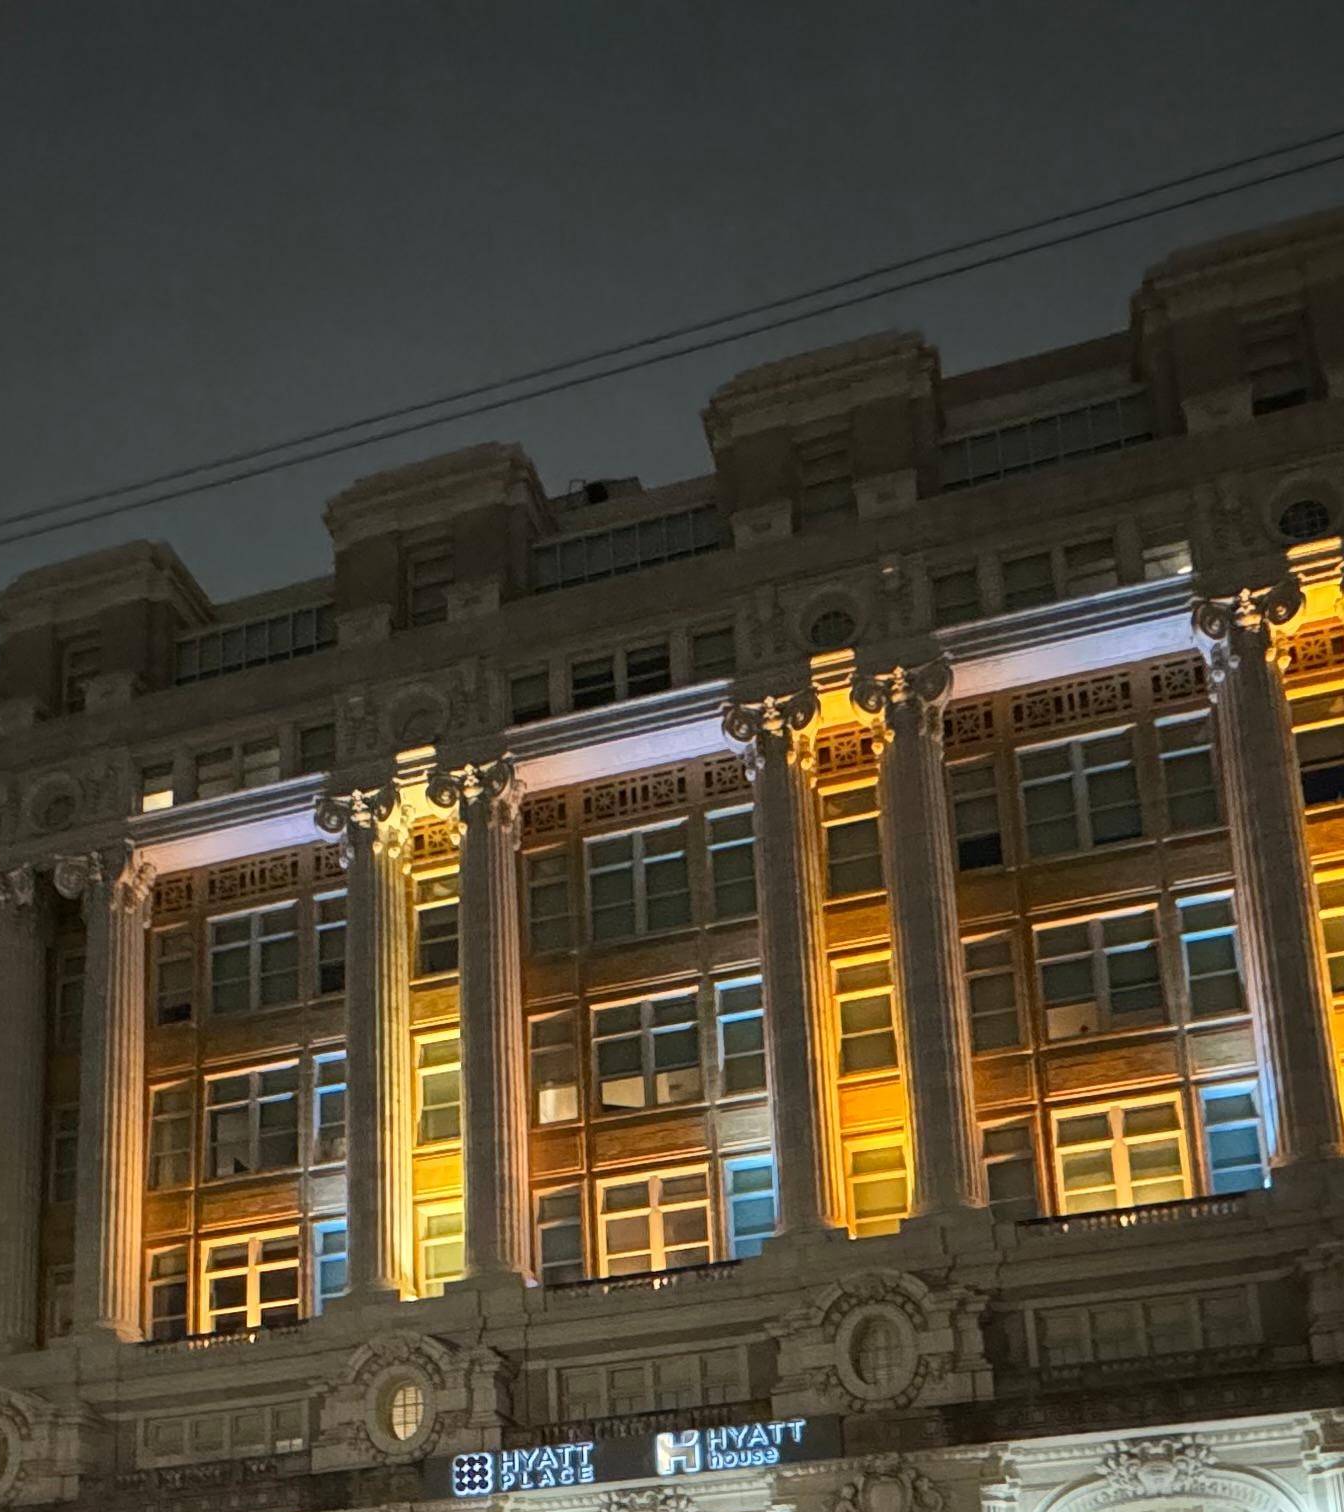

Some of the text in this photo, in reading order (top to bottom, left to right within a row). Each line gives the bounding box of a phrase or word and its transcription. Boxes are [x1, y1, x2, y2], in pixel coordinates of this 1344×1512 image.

[706, 1419, 808, 1451] HYATT
[499, 1442, 595, 1474] HYATT
[706, 1446, 780, 1470] house
[500, 1464, 596, 1491] PLACE
